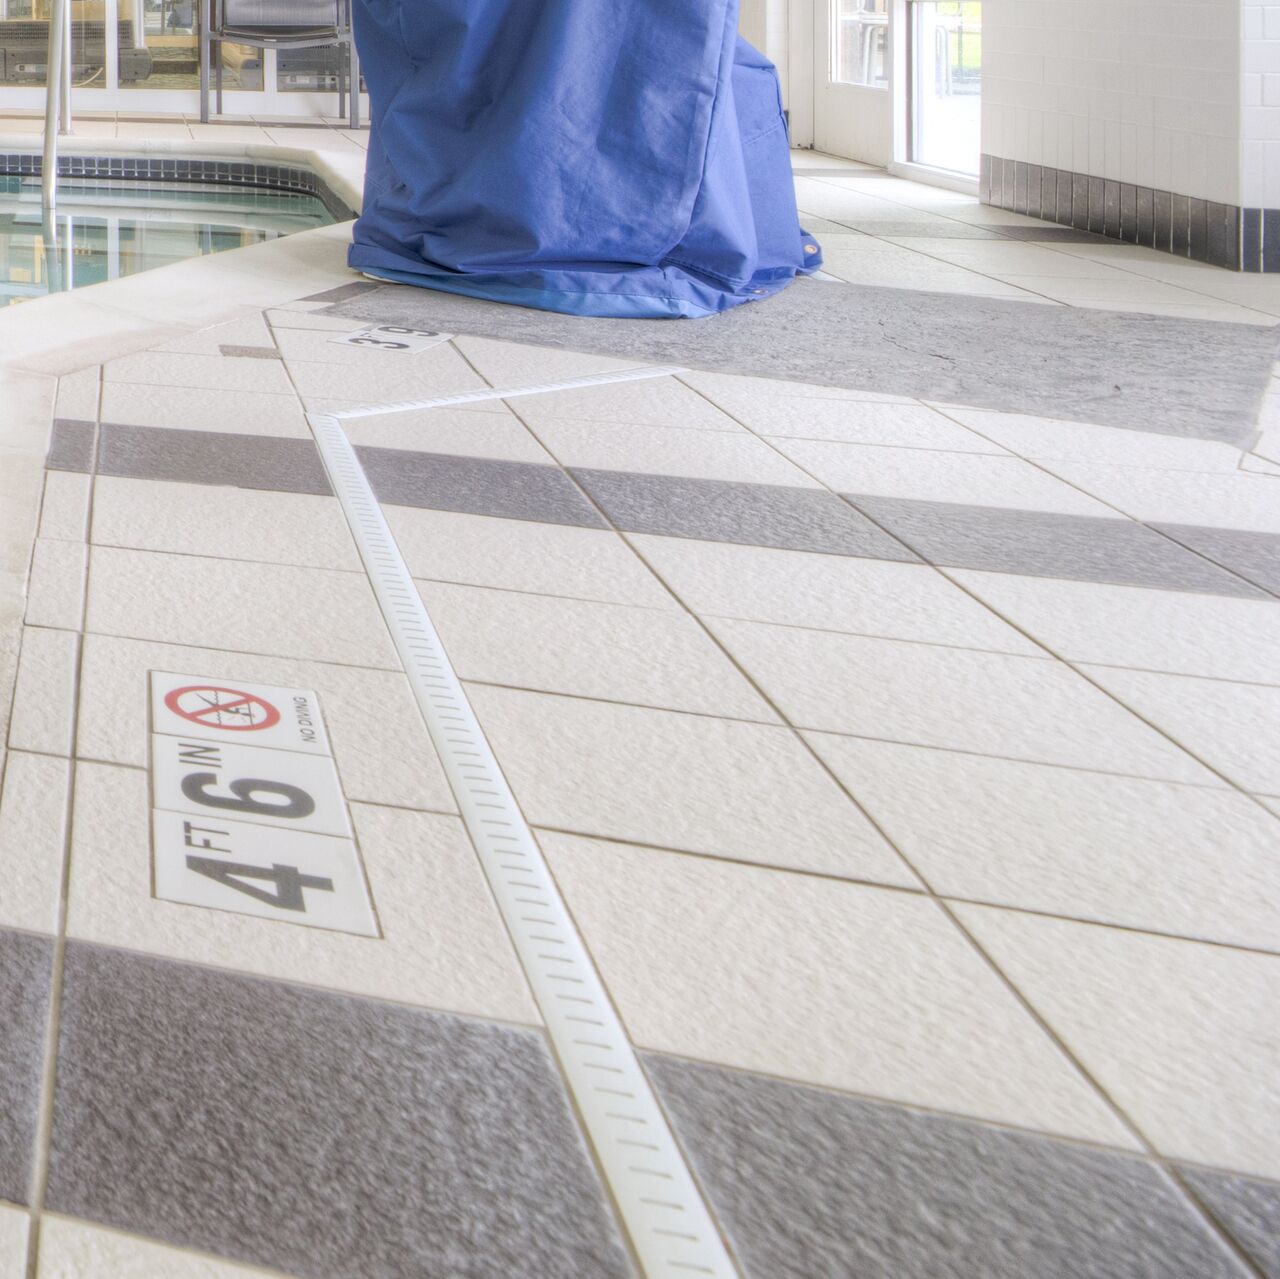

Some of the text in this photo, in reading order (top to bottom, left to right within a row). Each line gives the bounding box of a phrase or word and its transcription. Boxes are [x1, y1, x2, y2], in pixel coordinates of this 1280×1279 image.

[292, 696, 318, 744] NO DIVING
[177, 741, 336, 913] 4 FT 6 IN
